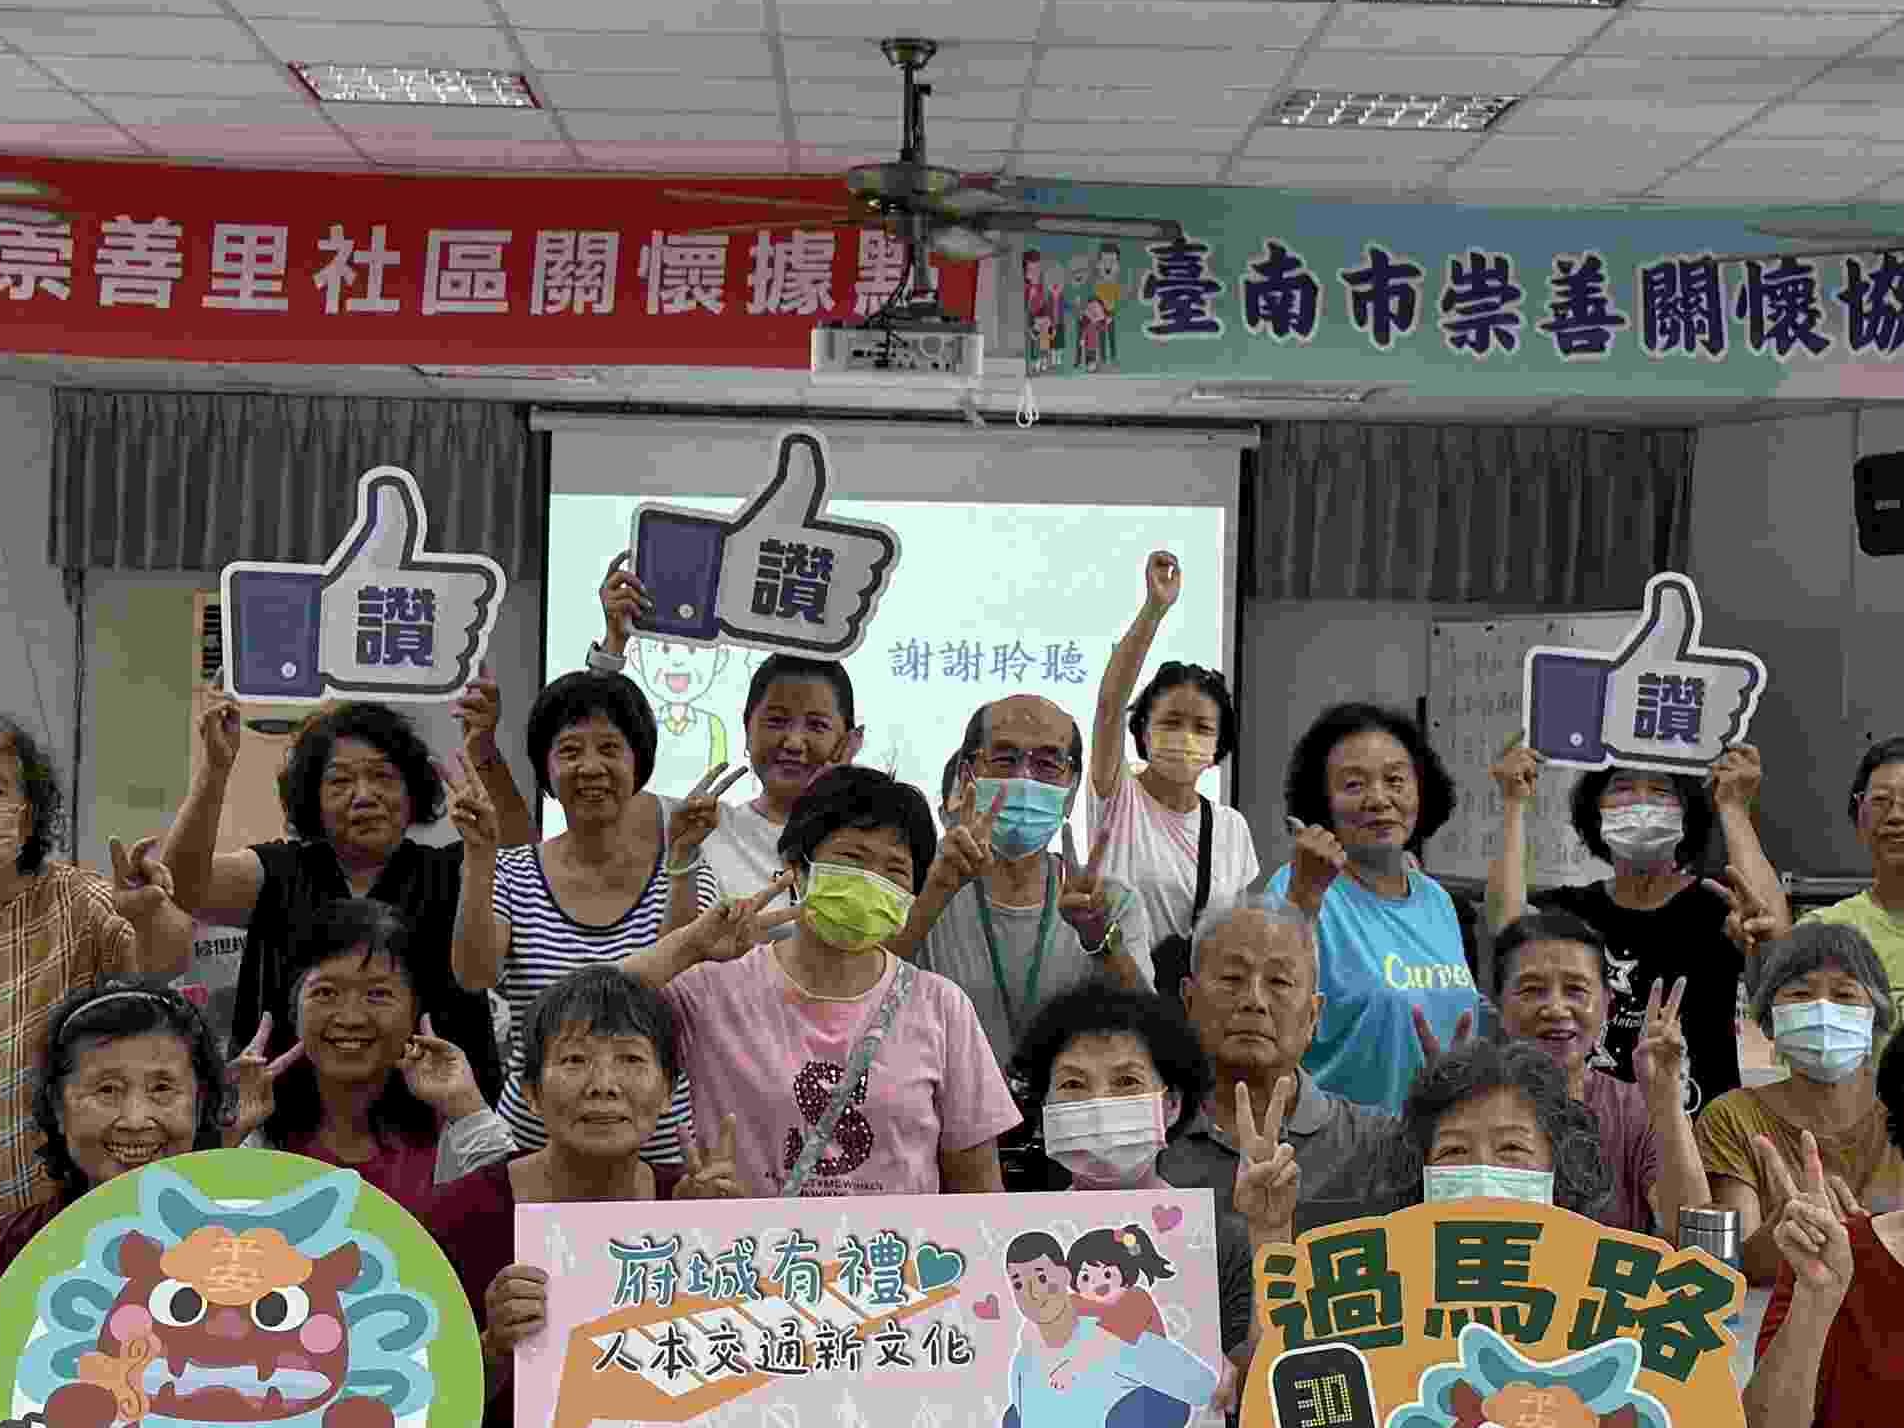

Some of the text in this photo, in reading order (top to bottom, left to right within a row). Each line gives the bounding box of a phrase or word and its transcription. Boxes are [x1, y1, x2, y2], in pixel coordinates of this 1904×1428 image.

[749, 536, 835, 625] 讚
[356, 584, 435, 667] 讚
[1633, 672, 1705, 745] 讚
[607, 1229, 910, 1308] 府城有禮
[1263, 1220, 1736, 1382] 過馬路
[593, 1318, 976, 1380] 人本交通新文化
